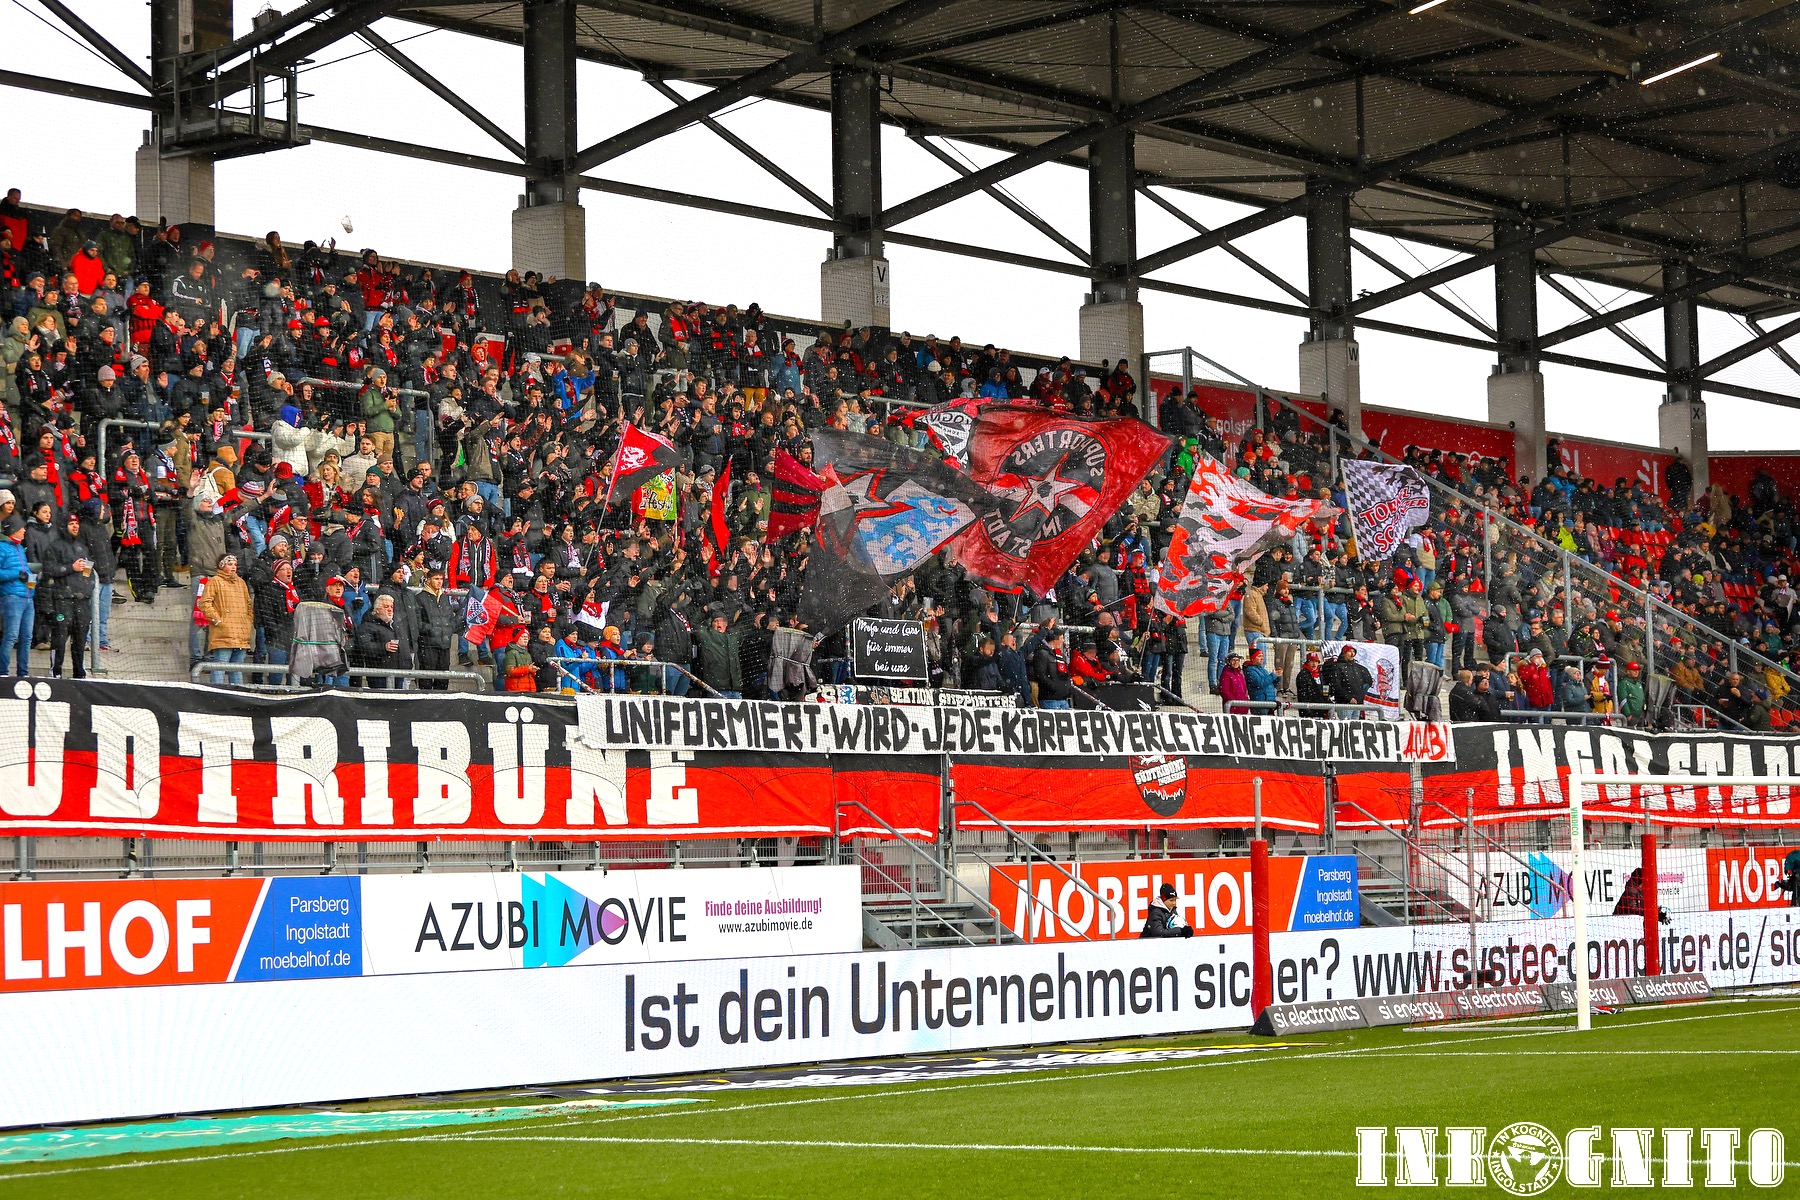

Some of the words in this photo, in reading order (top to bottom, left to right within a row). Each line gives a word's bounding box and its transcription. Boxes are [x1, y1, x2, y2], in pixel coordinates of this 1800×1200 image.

[881, 624, 900, 635] und
[902, 623, 920, 637] Lars
[866, 640, 882, 657] für
[885, 642, 913, 653] immer
[875, 660, 889, 672] bei
[891, 664, 910, 673] uns
[890, 686, 935, 706] SEKTION
[1492, 728, 1800, 815] INGOLSTAD
[1318, 868, 1351, 884] Parsberg
[290, 896, 348, 915] Parsberg
[1316, 888, 1353, 904] Ingolstadt
[705, 900, 733, 917] Finde
[736, 899, 762, 916] deine
[764, 898, 822, 915] Ausbildung!
[1303, 910, 1354, 924] moebelhof.de
[286, 922, 349, 944] Ingolstadt
[415, 900, 539, 952] AZUBI
[560, 896, 686, 946] MOVIE
[718, 917, 813, 934] www.azubimovie.de
[260, 949, 351, 971] moebelhof.de
[625, 974, 700, 1051] Ist
[718, 966, 830, 1044] dein
[851, 951, 1179, 1034] Unternehmen
[1194, 938, 1340, 1010] sicer?
[1574, 985, 1620, 1004] ergy
[1633, 980, 1646, 998] si
[1647, 976, 1709, 997] electronics
[1457, 992, 1470, 1010] si
[1471, 987, 1543, 1008] electronics
[1273, 1007, 1289, 1028] si
[1290, 1003, 1360, 1025] electronics
[1379, 999, 1393, 1020] si
[1394, 1001, 1445, 1020] energy
